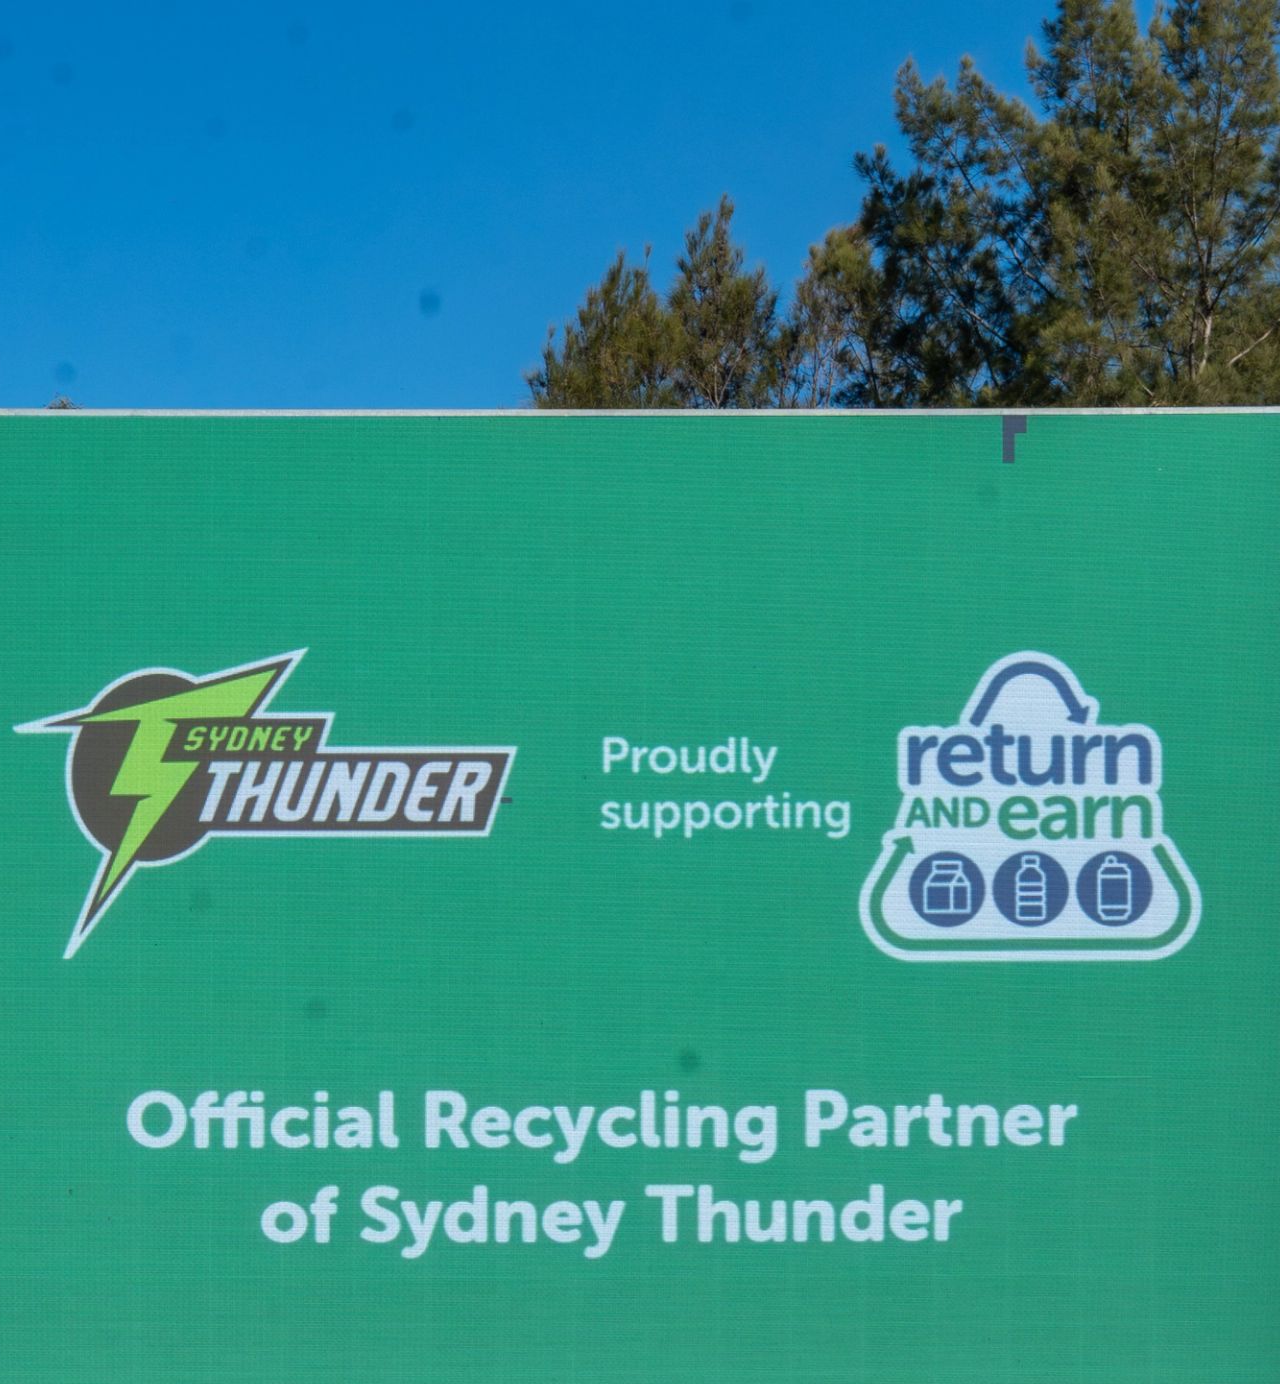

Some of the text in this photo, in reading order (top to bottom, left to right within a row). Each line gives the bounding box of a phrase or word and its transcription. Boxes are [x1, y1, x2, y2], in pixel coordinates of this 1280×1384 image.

[183, 726, 313, 752] SYDNEY
[602, 736, 777, 783] Proudly
[907, 724, 1153, 787] return
[198, 760, 493, 823] THUNDER
[601, 791, 851, 838] supporting
[905, 795, 1153, 840] AND earn
[126, 1089, 1078, 1164] Official Recycling Partner
[260, 1183, 963, 1259] of Sydney Thunder
